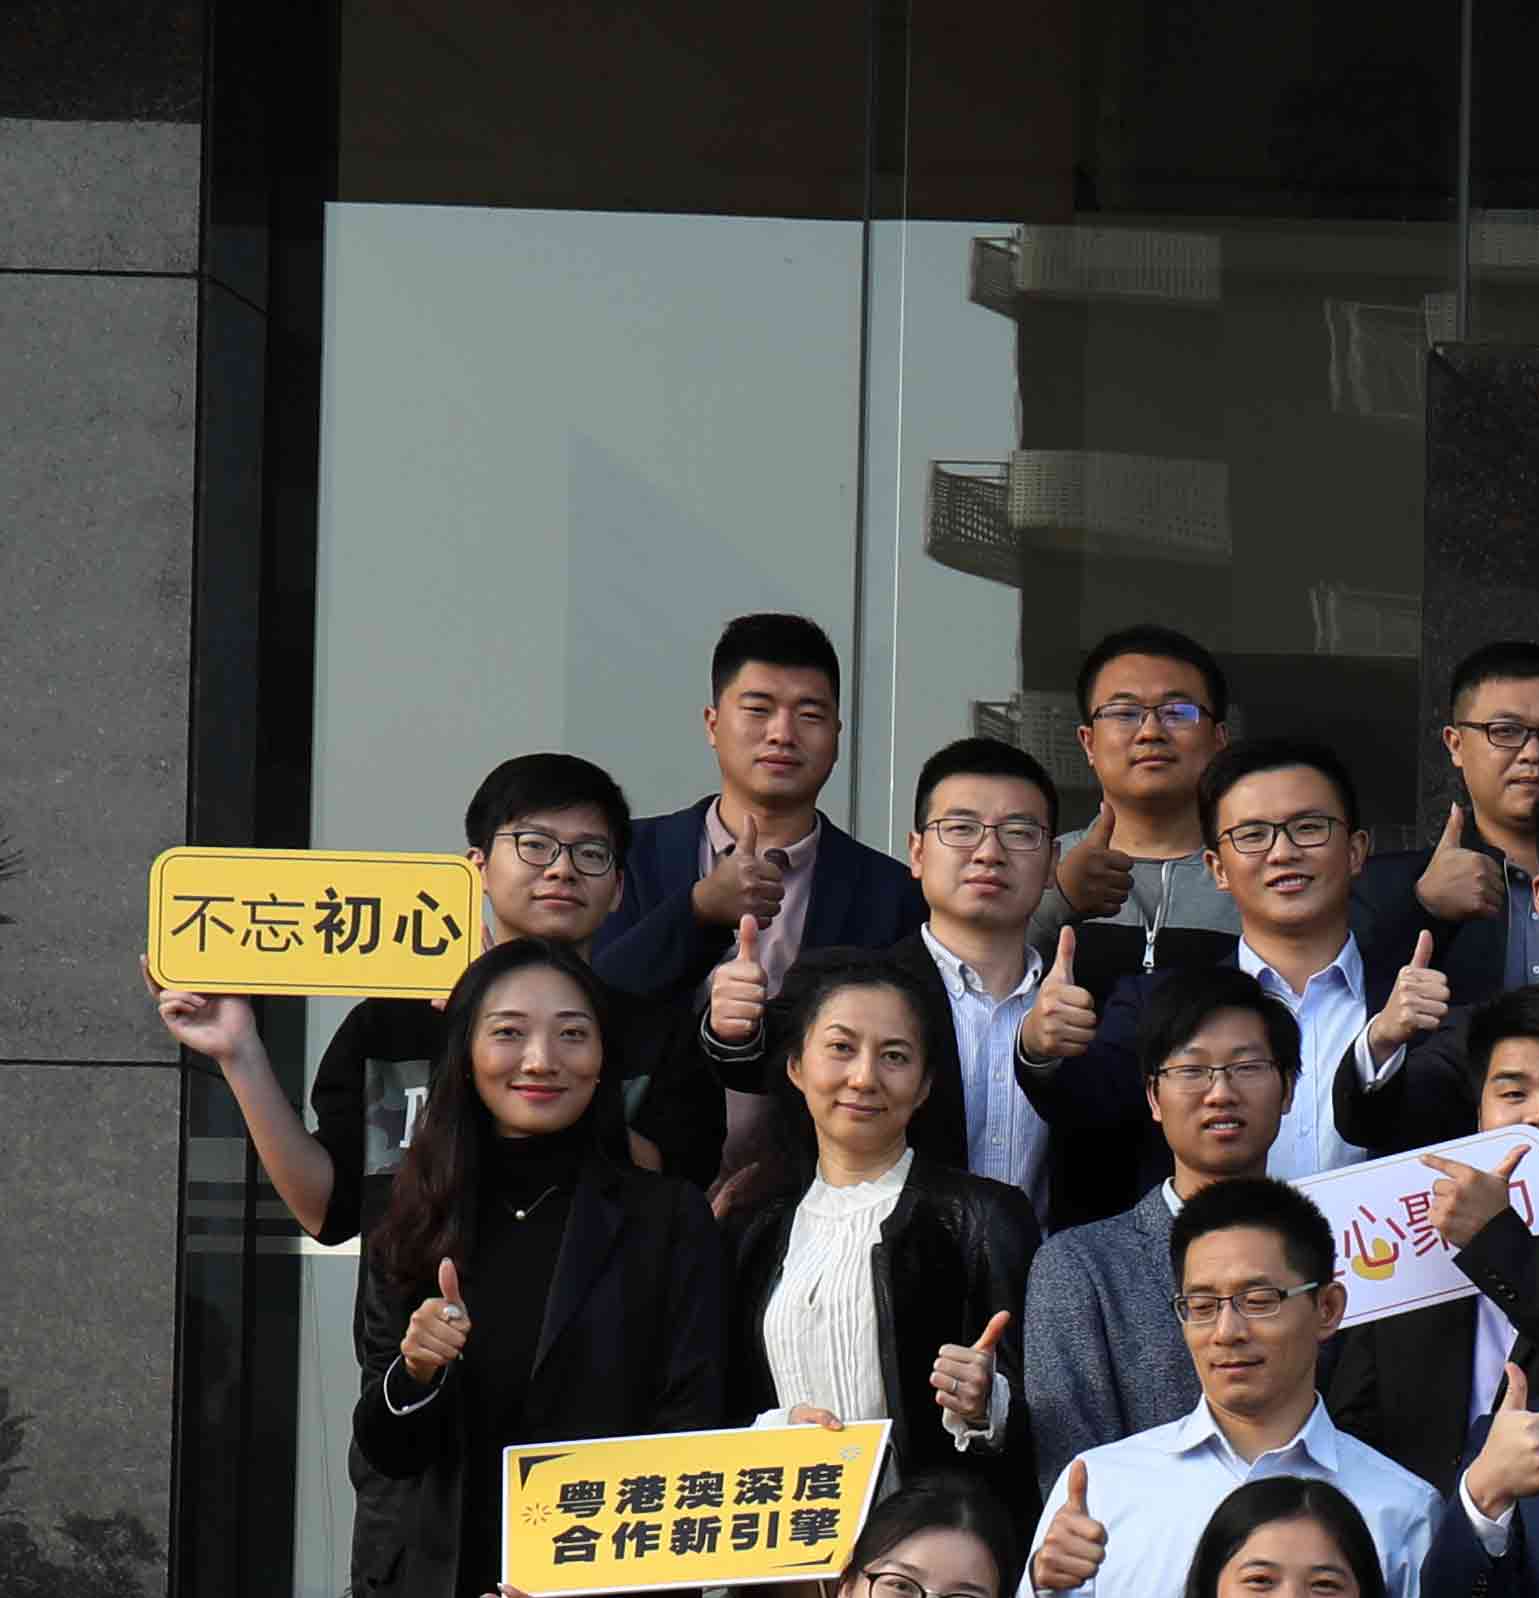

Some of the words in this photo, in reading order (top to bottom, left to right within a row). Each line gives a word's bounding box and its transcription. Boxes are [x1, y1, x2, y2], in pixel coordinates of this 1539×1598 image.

[171, 886, 463, 956] 不忘初心
[555, 1462, 845, 1519] 粤港澳深度
[551, 1507, 842, 1565] 合作新引擎
